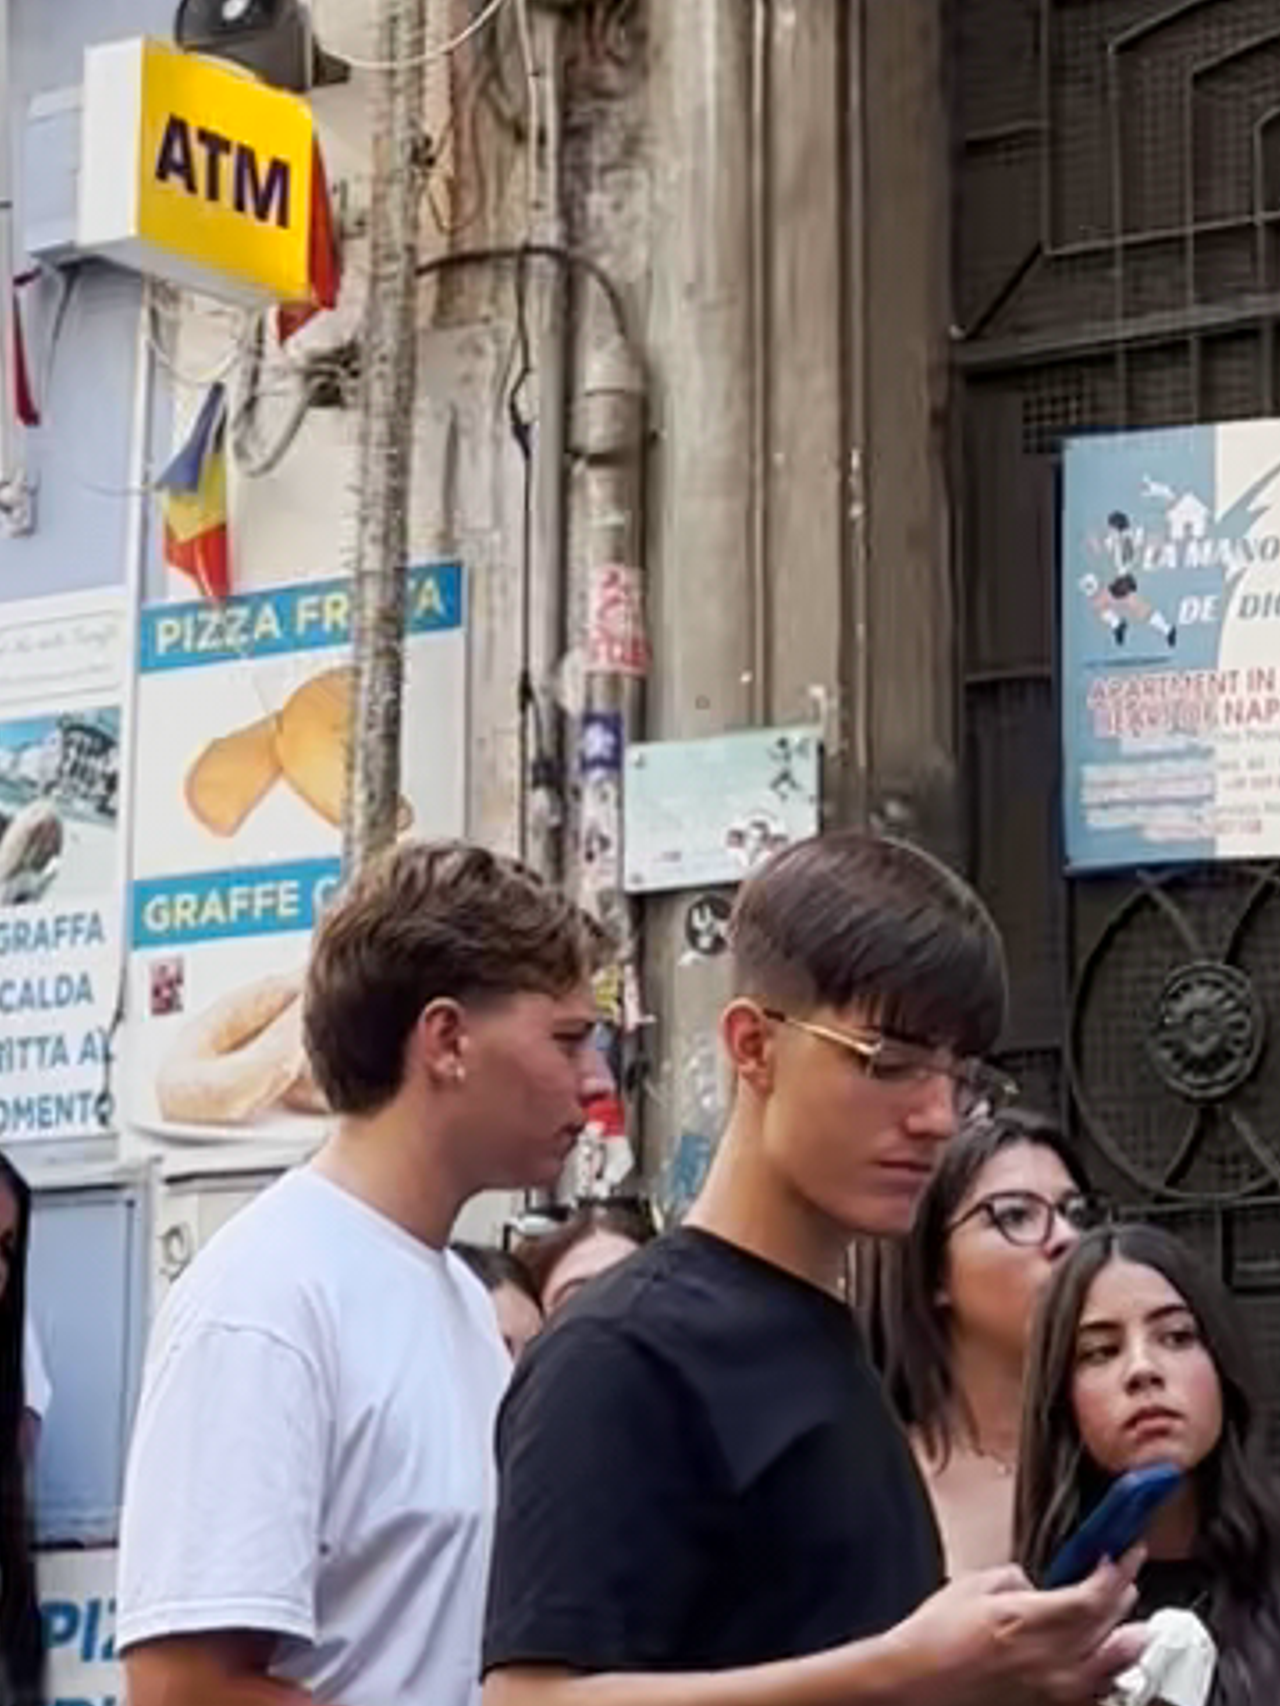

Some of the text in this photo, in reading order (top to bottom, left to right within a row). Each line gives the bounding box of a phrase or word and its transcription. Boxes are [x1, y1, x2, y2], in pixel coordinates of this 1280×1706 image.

[154, 115, 291, 229] ATM
[155, 603, 282, 657] PIZZA
[296, 577, 446, 634] FRA
[1178, 594, 1220, 625] DE
[1246, 667, 1275, 693] IN
[144, 879, 302, 933] GRAFFE
